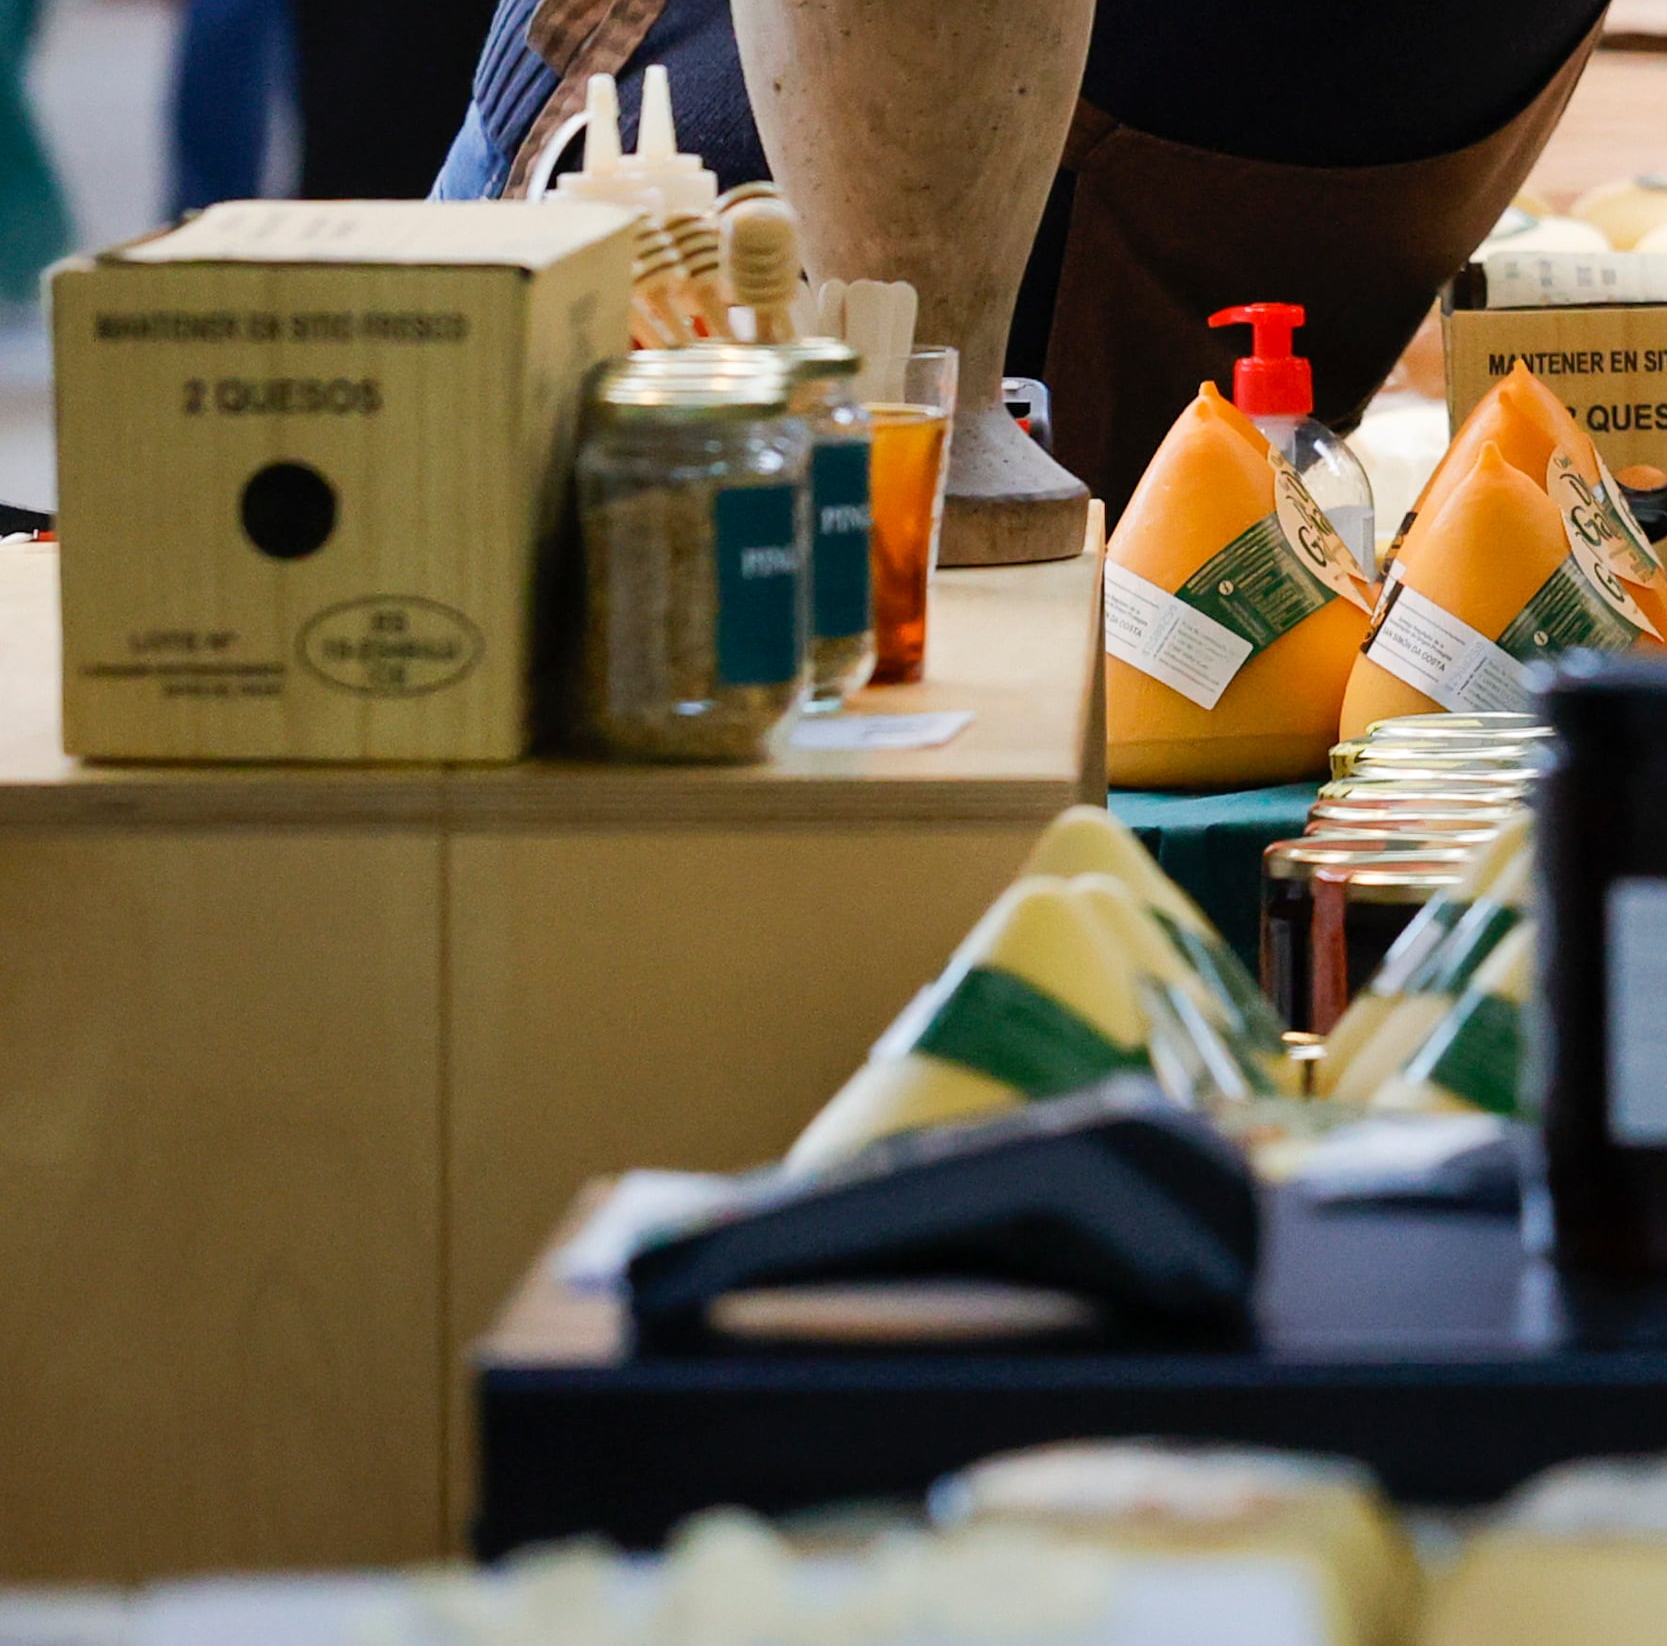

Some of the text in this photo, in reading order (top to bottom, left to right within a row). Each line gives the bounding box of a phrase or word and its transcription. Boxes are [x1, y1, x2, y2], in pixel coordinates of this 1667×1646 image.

[1611, 351, 1641, 372] EN
[215, 376, 382, 414] QUESOS
[1118, 618, 1144, 638] COSTA
[1411, 645, 1422, 656] DA
[1421, 651, 1447, 672] COSTA
